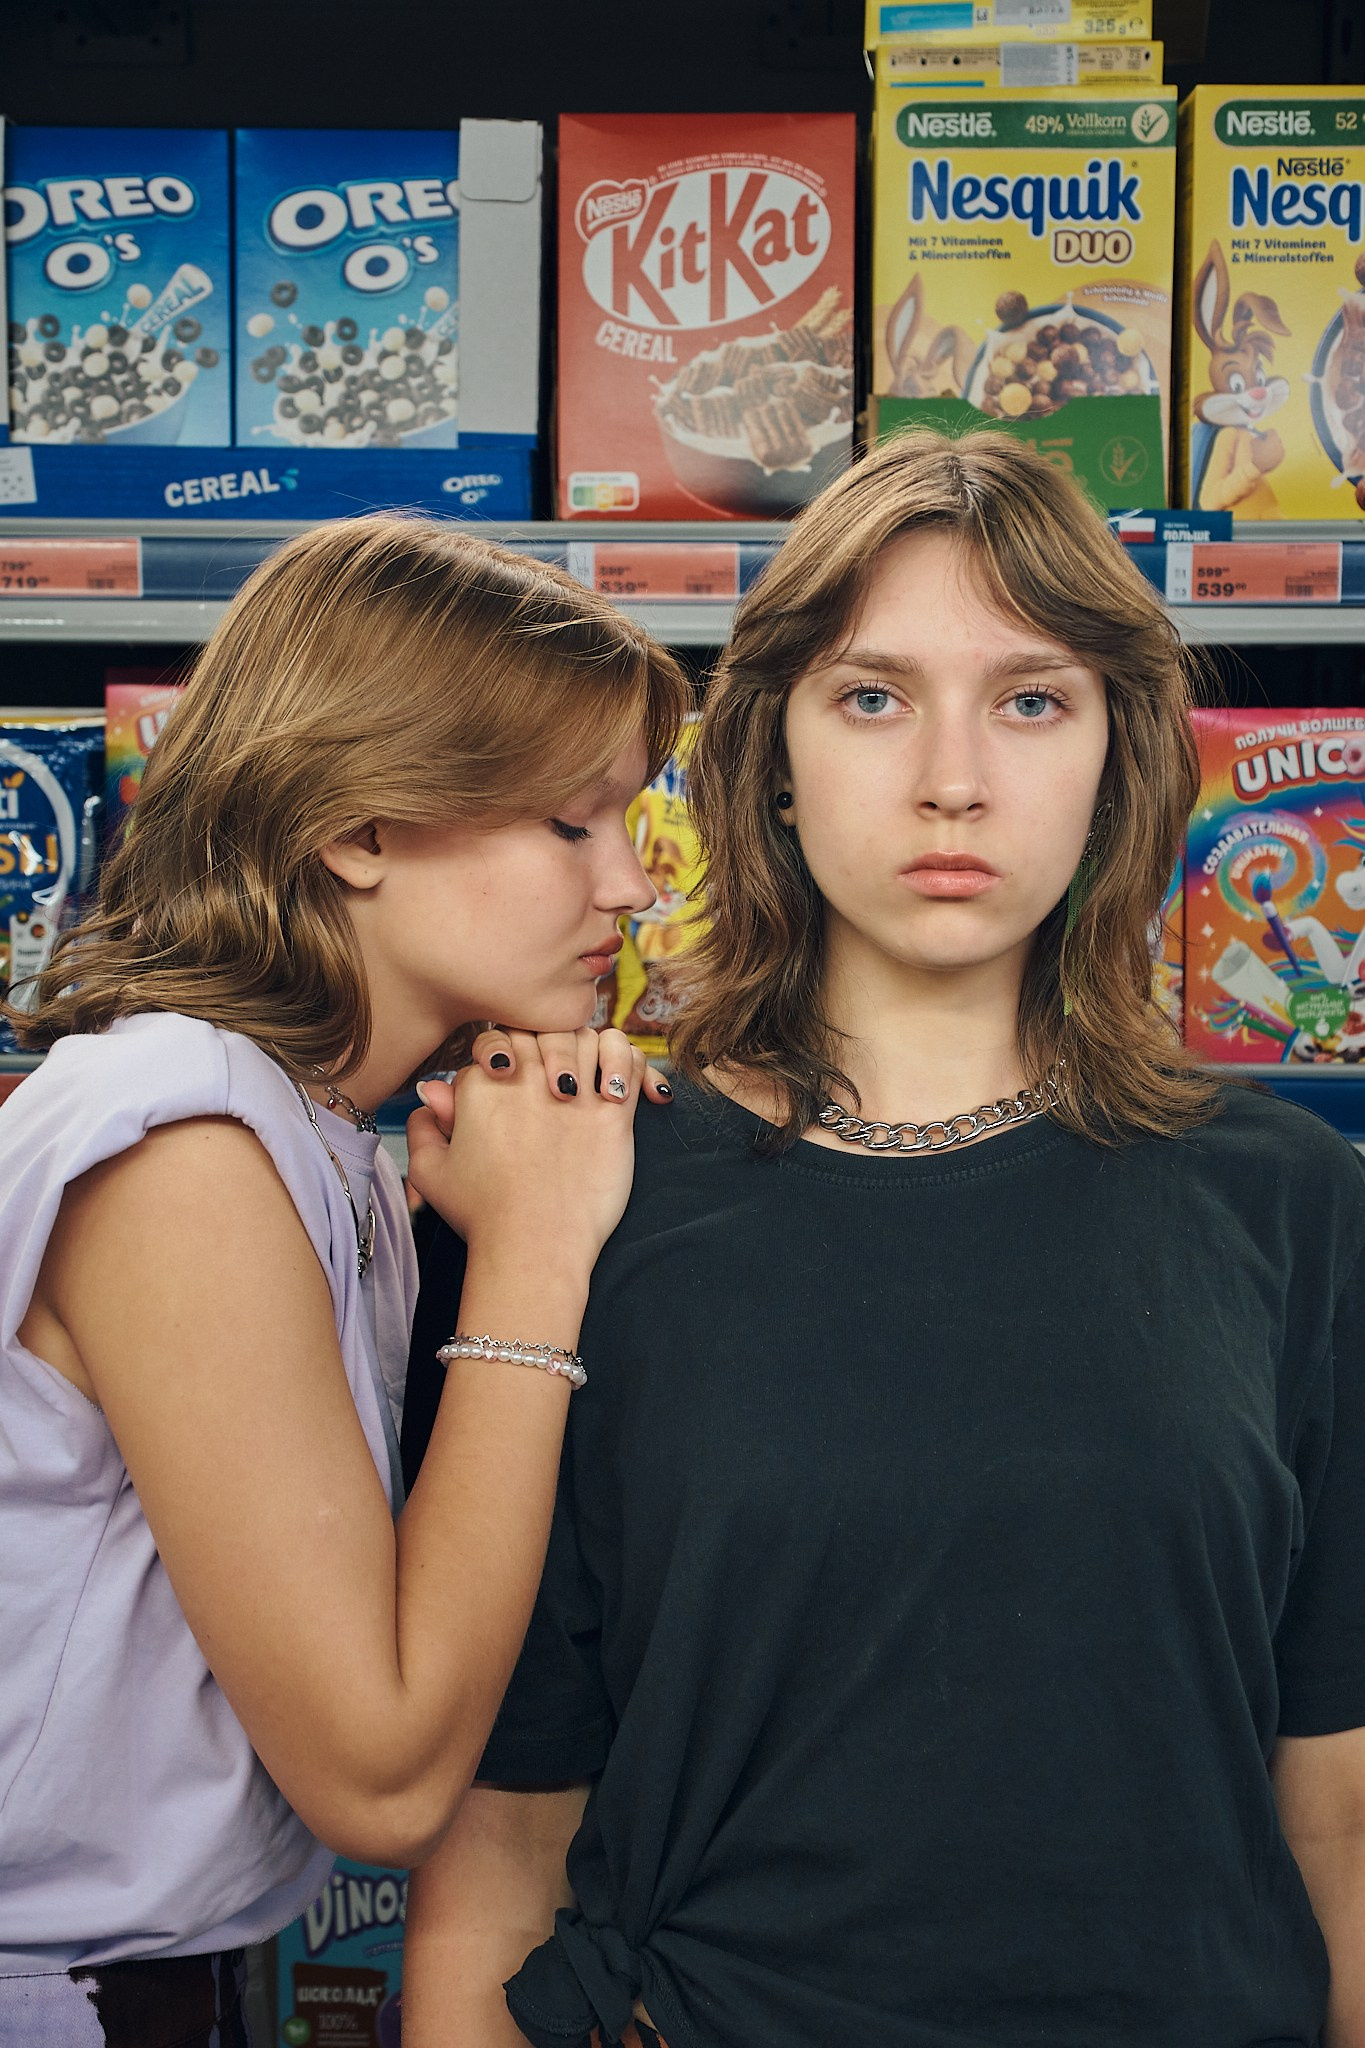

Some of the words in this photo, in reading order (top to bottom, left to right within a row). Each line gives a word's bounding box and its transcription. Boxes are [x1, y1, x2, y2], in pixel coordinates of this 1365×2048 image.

[1084, 18, 1116, 34] 325
[1025, 115, 1064, 135] 49%
[1066, 113, 1127, 129] Vollkorn
[1335, 112, 1358, 130] 52
[912, 160, 1141, 237] Nesquik
[1232, 167, 1361, 243] Nesq
[271, 179, 459, 247] ORE
[908, 236, 927, 247] Mit
[931, 236, 939, 247] 7
[941, 236, 1004, 247] Vitaminen
[1054, 230, 1132, 264] DUO
[1231, 239, 1250, 249] Mit
[1254, 239, 1261, 249] 7
[1264, 238, 1327, 249] Vitaminen
[908, 250, 918, 260] &
[921, 249, 1012, 261] Mineralstoffen
[1231, 253, 1241, 263] &
[1244, 252, 1335, 263] Mineralstoffen
[595, 320, 678, 364] CEREAL
[164, 468, 281, 508] CEREAL
[1197, 582, 1235, 597] 539
[1235, 722, 1298, 750] ПОЛУЧИ
